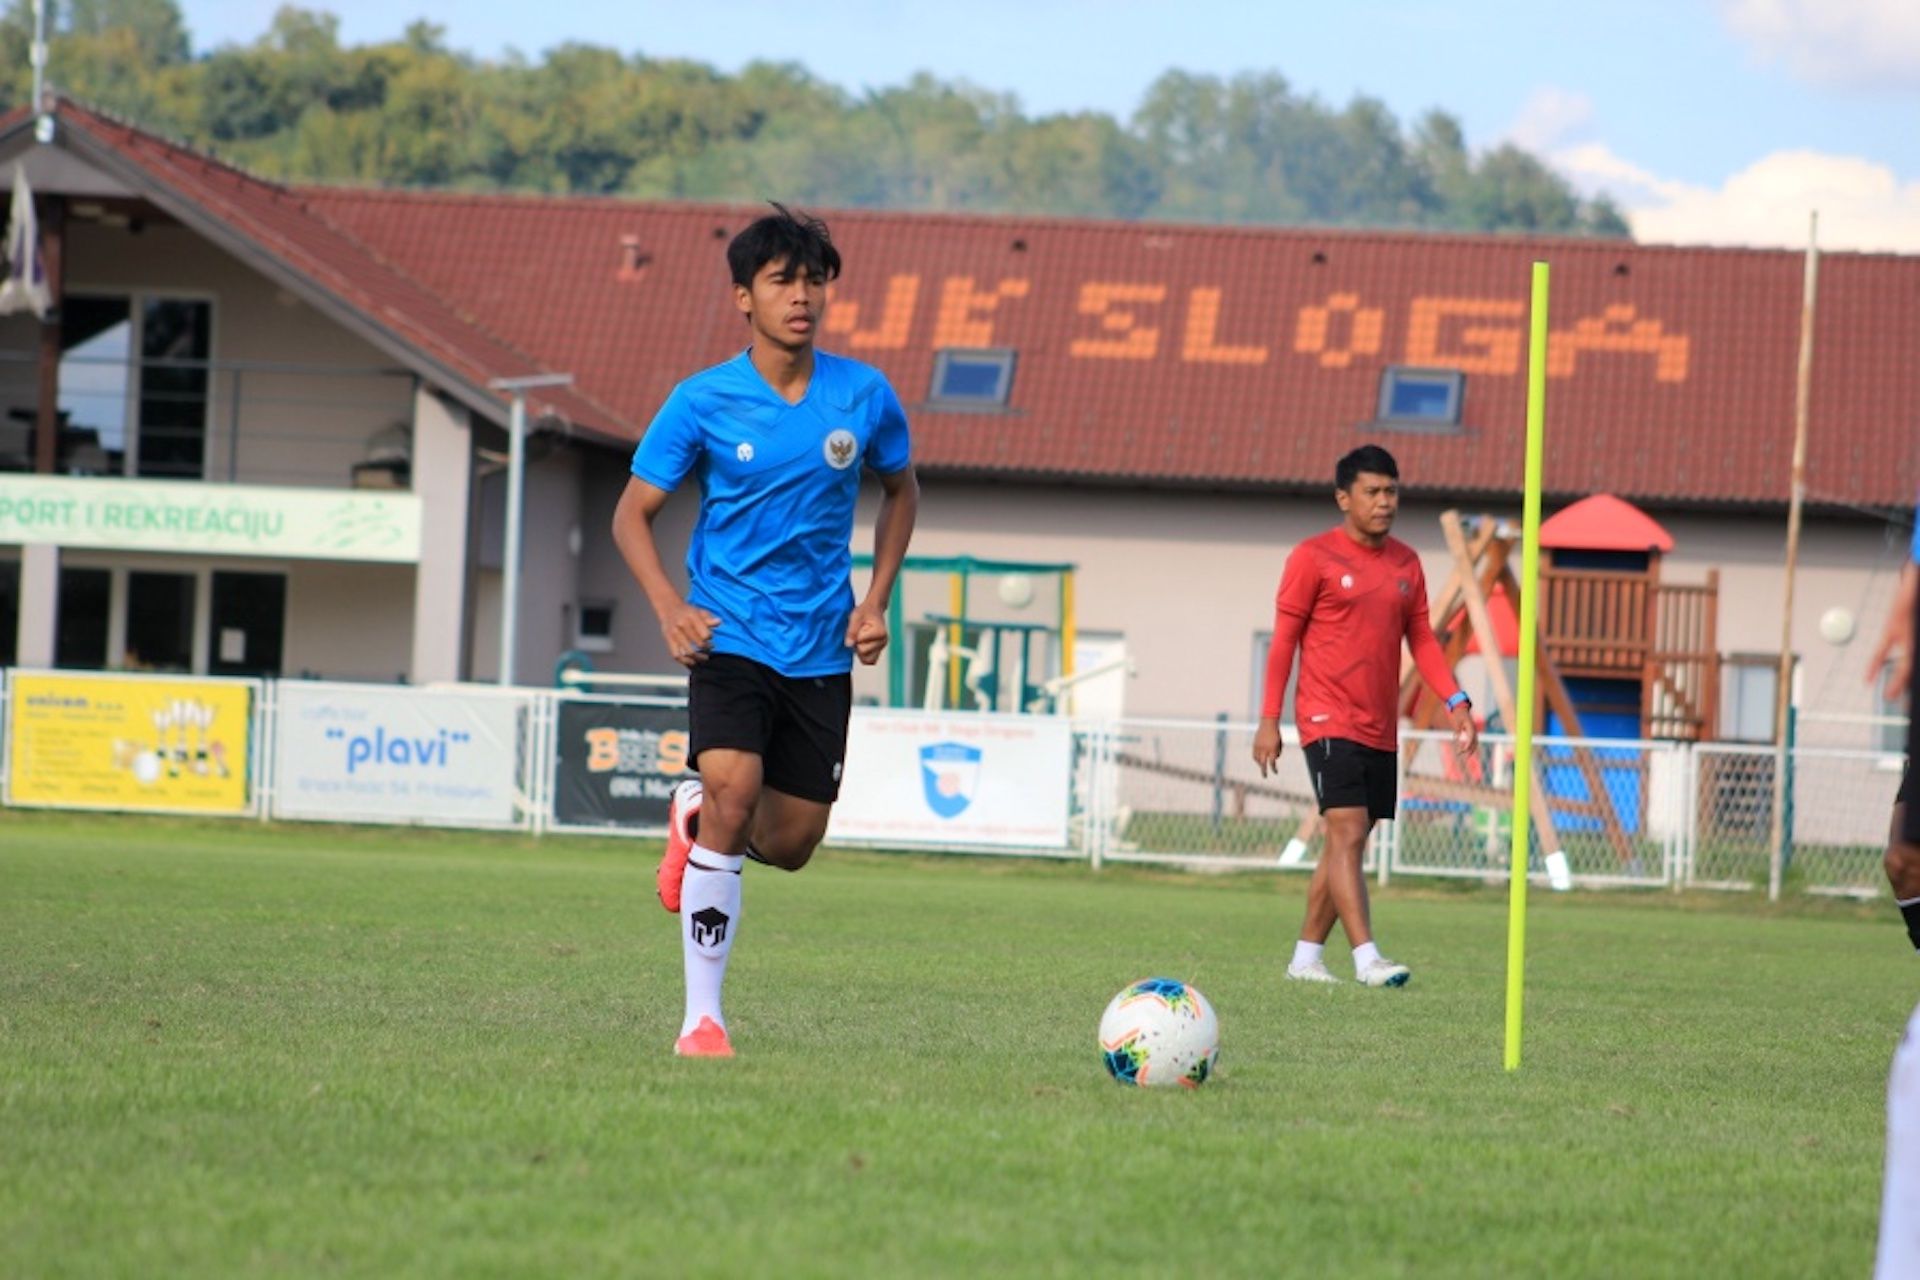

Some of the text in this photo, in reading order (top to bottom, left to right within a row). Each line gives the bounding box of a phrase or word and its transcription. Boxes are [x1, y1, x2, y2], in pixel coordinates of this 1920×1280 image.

[1069, 280, 1690, 382] SLOGA
[86, 502, 95, 528] I
[103, 503, 284, 539] REKREACIJU
